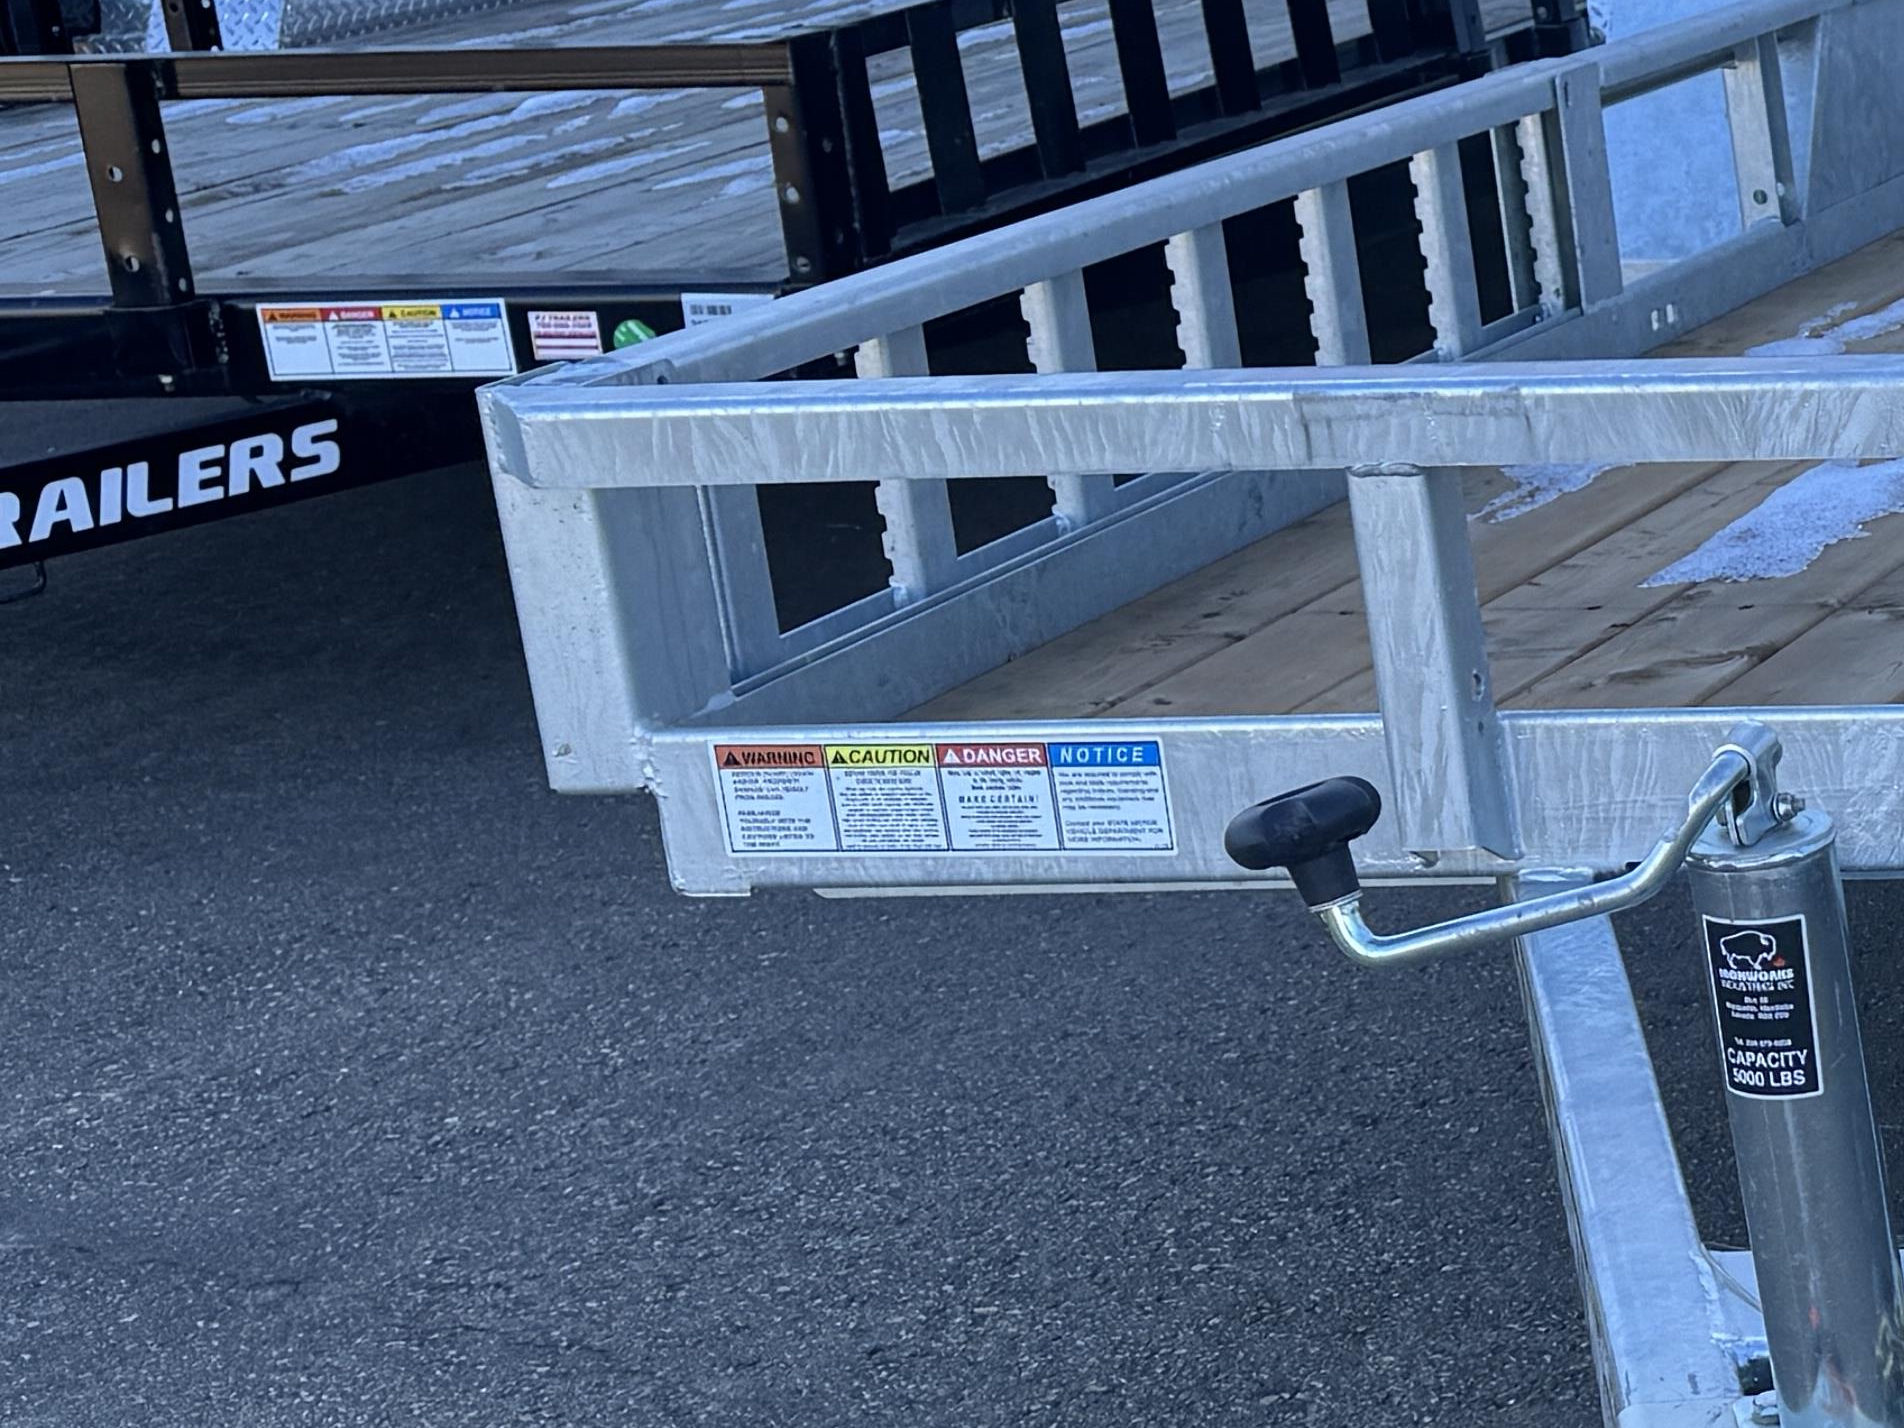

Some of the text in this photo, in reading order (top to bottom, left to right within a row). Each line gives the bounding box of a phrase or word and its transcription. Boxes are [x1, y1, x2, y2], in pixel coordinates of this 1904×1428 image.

[400, 309, 437, 318] CAUTION
[741, 751, 816, 765] WARNING
[851, 749, 930, 764] CAUTION
[963, 748, 1043, 764] DANGER
[1060, 747, 1143, 763] NOTICE
[1727, 1047, 1808, 1069] CAPACITY
[1732, 1067, 1806, 1087] 5000 LBS
